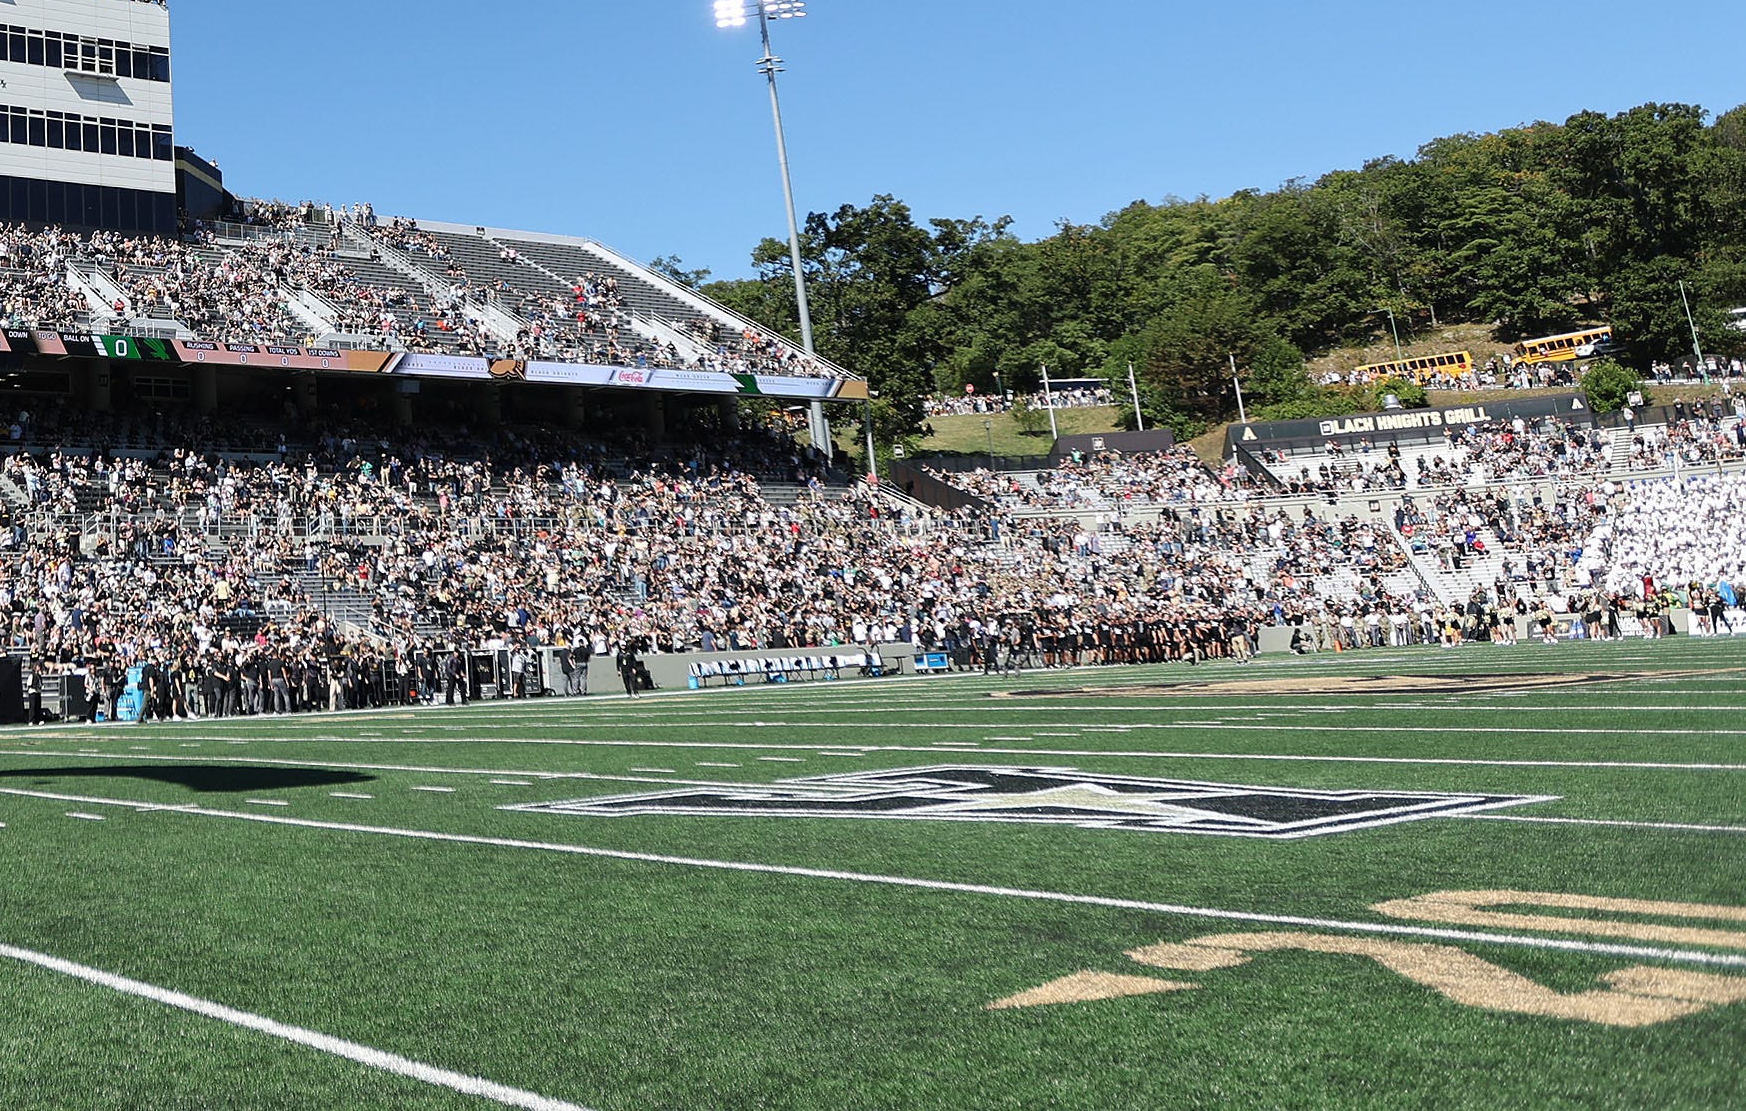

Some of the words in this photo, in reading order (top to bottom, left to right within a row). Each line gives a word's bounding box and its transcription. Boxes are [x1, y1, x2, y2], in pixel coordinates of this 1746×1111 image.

[8, 331, 28, 339] DOWN
[63, 334, 78, 342] BALL
[115, 339, 128, 357] 0
[186, 342, 214, 350] RUSHING
[269, 347, 284, 355] TOTAL
[1376, 411, 1442, 430] KNIGHTS
[1444, 406, 1492, 425] GRILL
